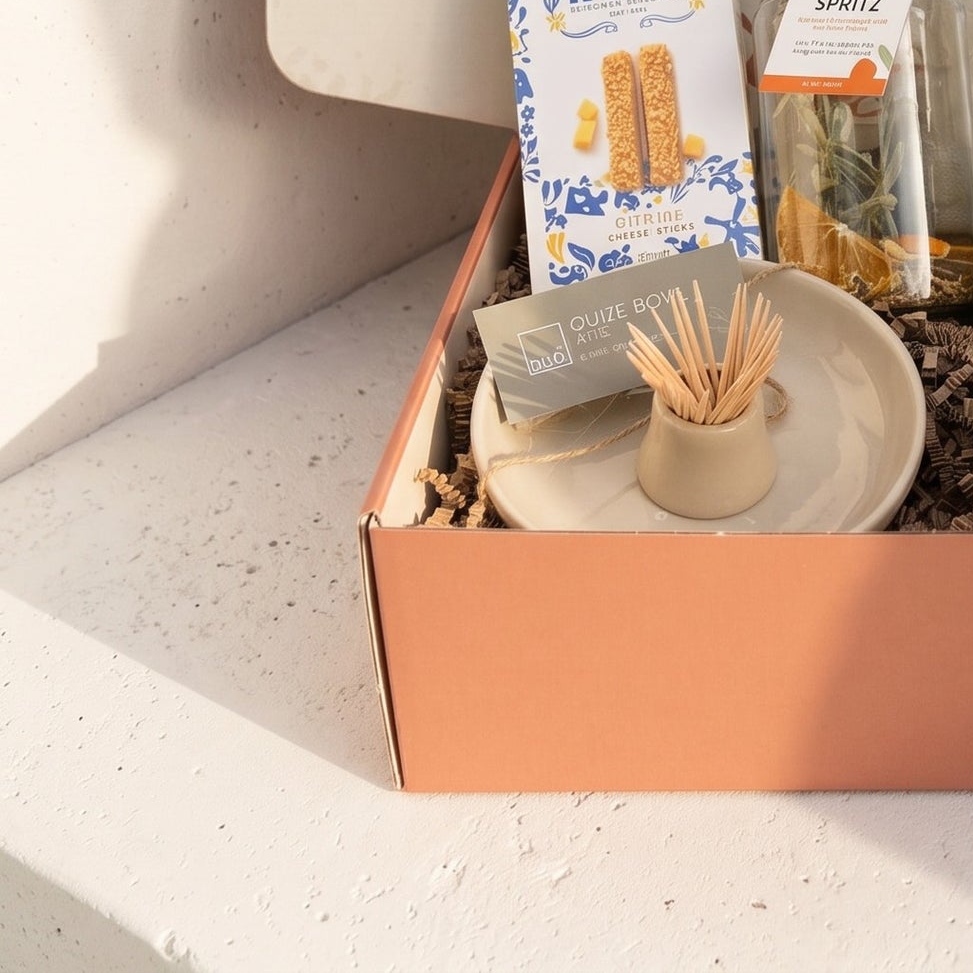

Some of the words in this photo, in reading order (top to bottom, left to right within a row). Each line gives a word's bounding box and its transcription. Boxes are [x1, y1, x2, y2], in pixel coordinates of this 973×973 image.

[608, 229, 650, 243] CHEESE
[656, 222, 695, 236] STICKS
[632, 286, 689, 314] BOW
